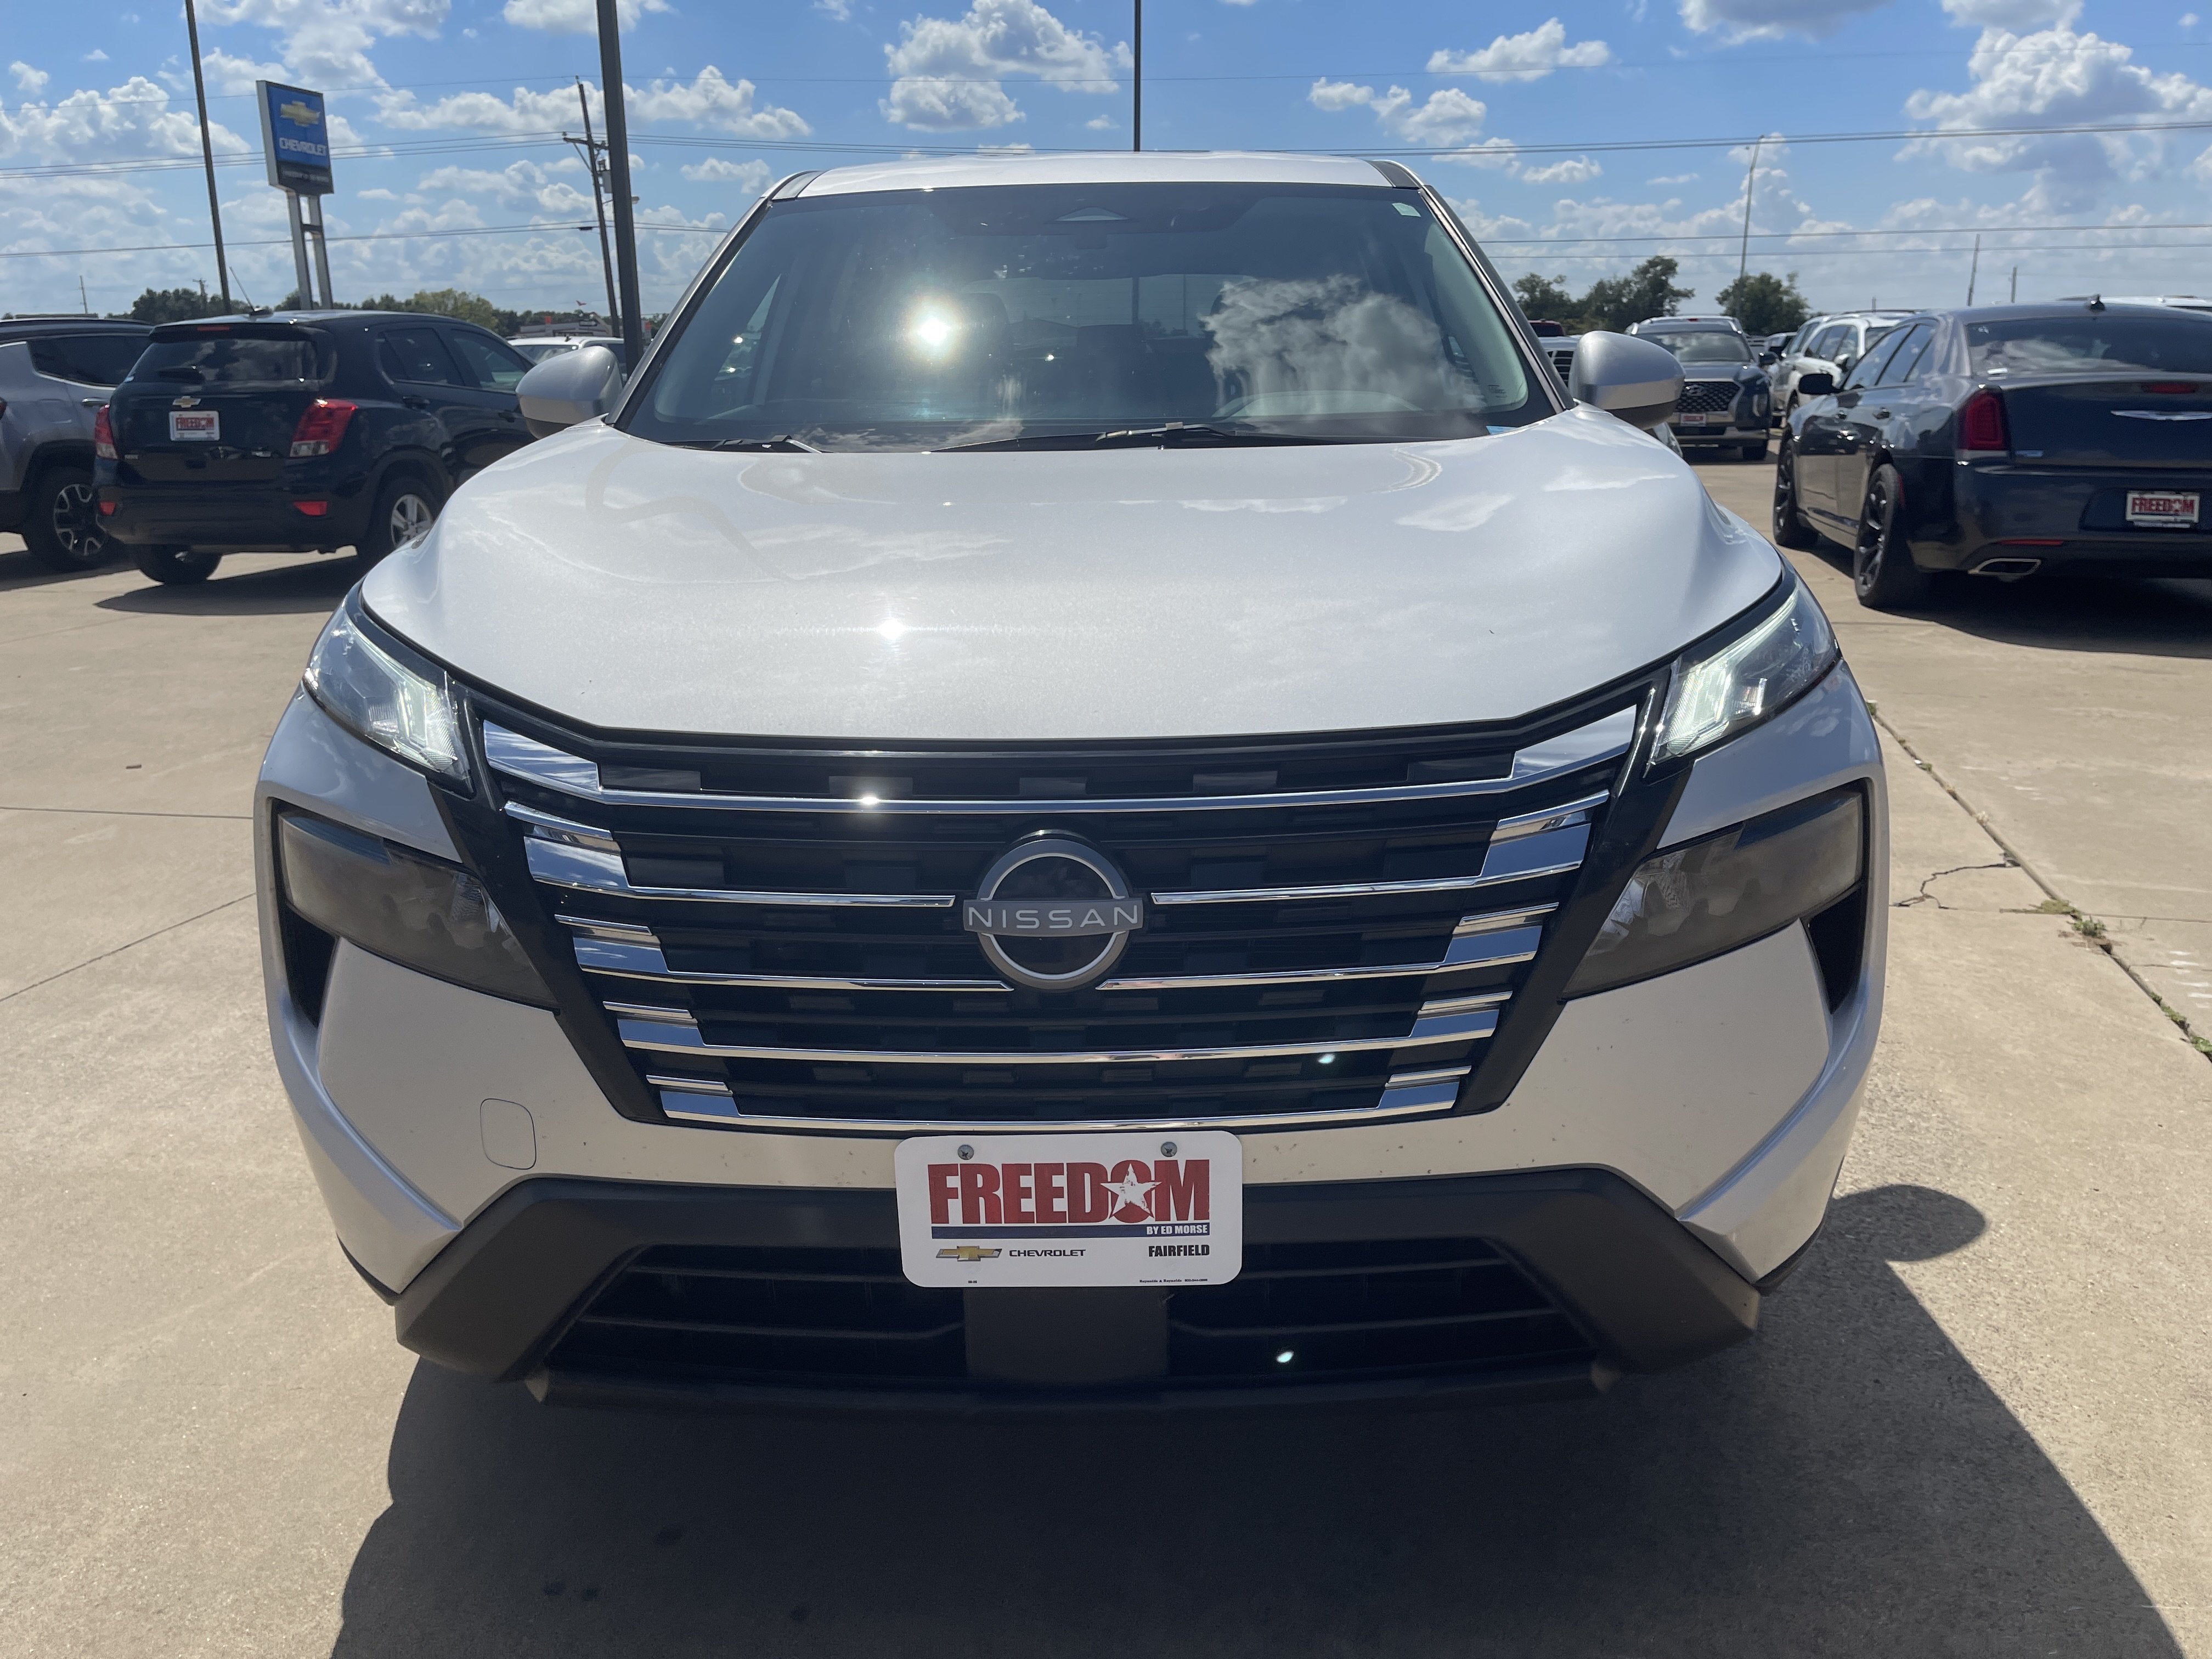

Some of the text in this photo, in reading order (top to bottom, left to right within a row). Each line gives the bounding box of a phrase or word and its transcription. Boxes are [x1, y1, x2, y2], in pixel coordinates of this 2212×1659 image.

[279, 138, 327, 156] CHEVROLET
[2132, 498, 2195, 512] FREEDOM
[968, 904, 1138, 929] NISSAN
[928, 1159, 1210, 1224] FREEDOM
[1147, 1224, 1207, 1235] BY ED MORSE
[1148, 1244, 1210, 1257] FAIRFIELD
